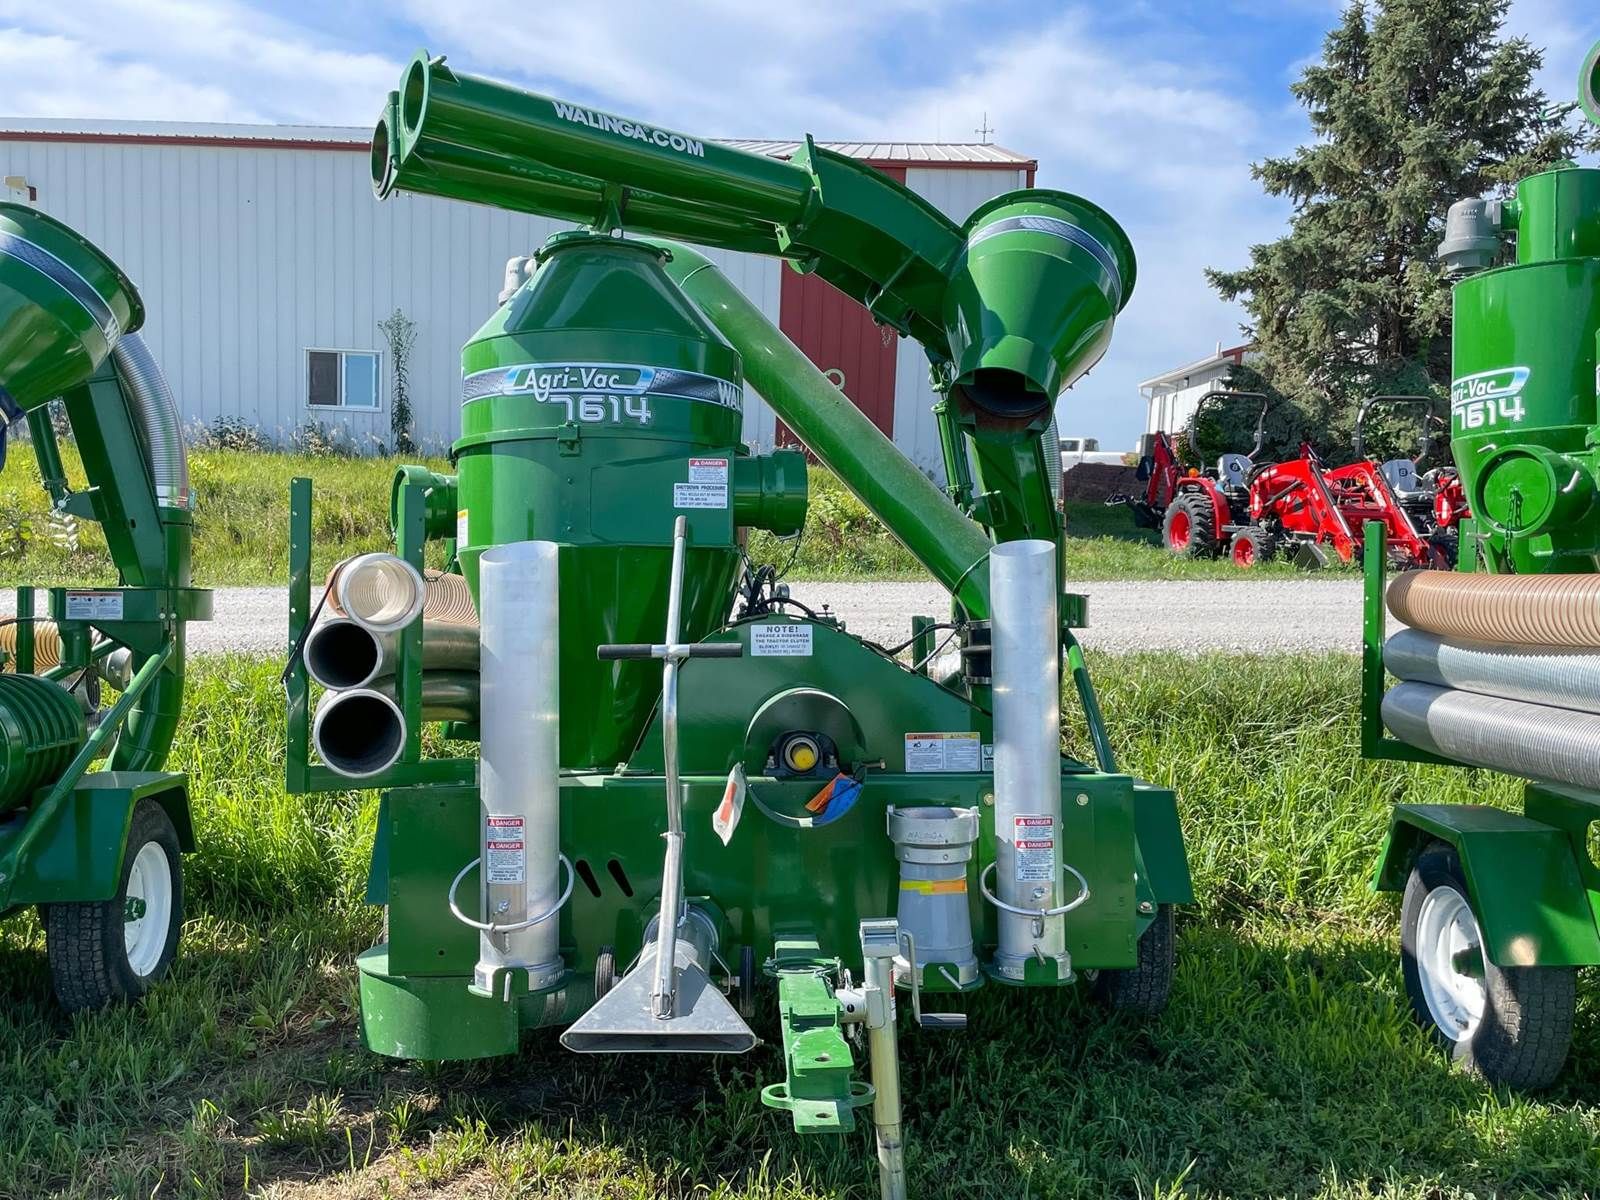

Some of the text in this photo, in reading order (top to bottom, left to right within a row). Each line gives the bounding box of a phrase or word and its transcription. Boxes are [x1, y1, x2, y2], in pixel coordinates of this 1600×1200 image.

[552, 101, 705, 158] WALINGA.COM
[522, 367, 628, 402] Agri-Vac
[549, 394, 652, 425] 7614
[1454, 396, 1526, 432] 7614
[766, 625, 799, 633] NOTE!
